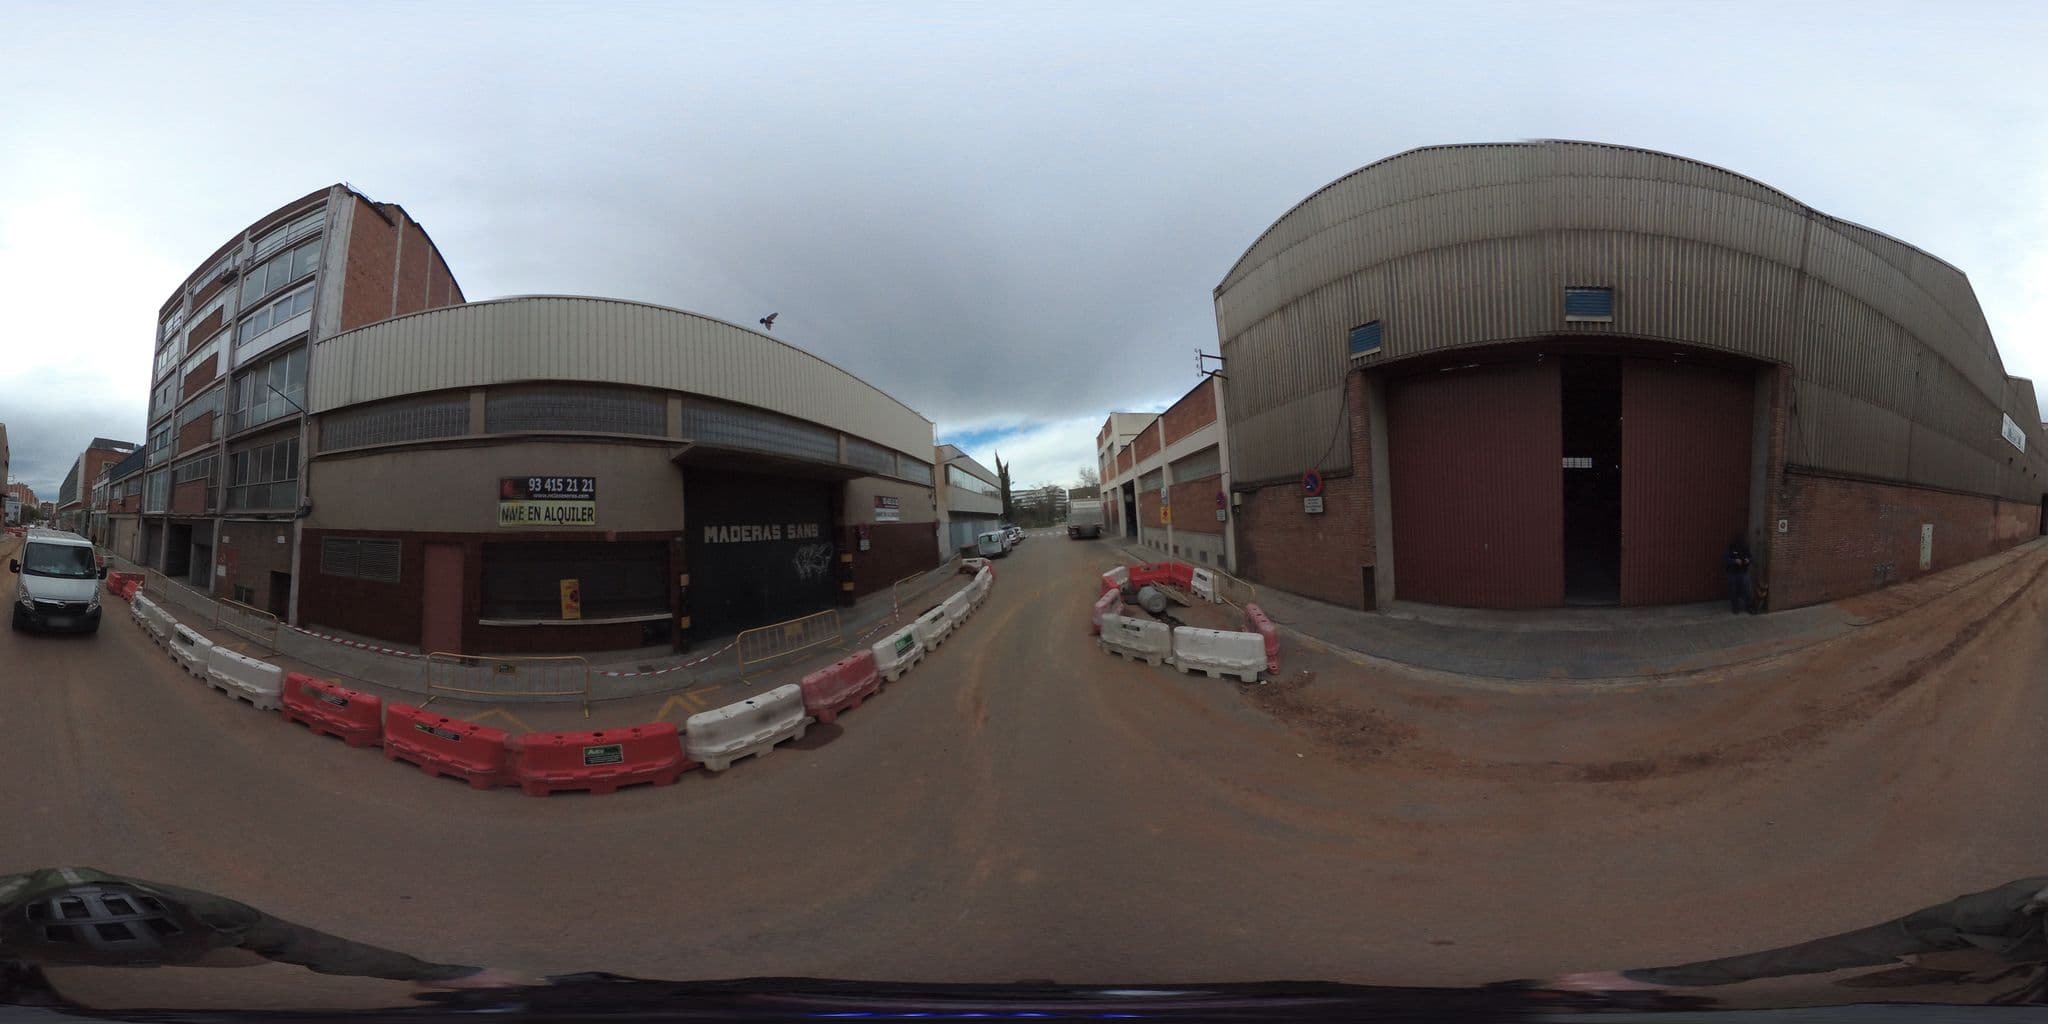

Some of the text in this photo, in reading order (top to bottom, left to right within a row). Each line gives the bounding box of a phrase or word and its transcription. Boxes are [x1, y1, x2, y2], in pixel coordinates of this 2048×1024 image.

[529, 478, 594, 492] 93 415 21 21
[528, 506, 541, 521] EN
[544, 506, 594, 524] ALQUILER
[704, 523, 819, 544] MADERAS SANS
